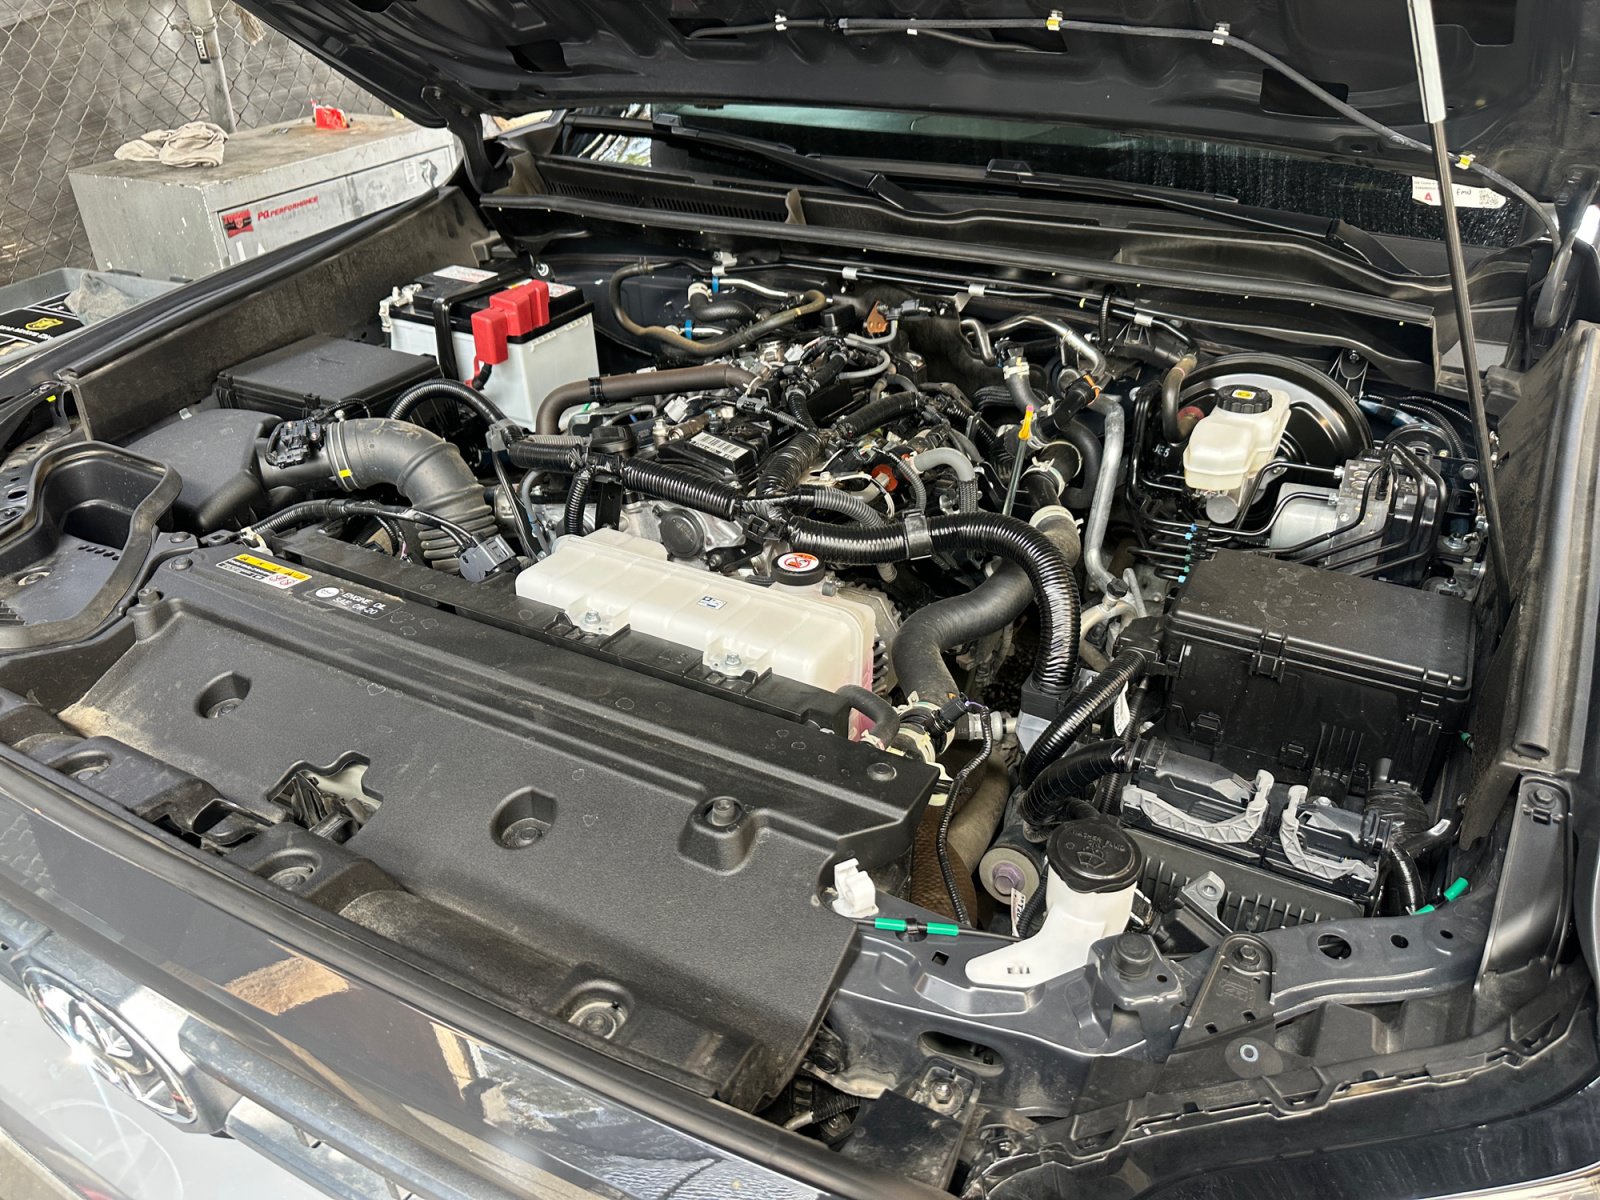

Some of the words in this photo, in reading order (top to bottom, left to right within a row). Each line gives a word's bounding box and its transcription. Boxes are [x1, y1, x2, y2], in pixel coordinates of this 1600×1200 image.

[270, 196, 318, 217] PERFORMANCE
[333, 596, 351, 606] SAE
[342, 591, 374, 605] ENGINE
